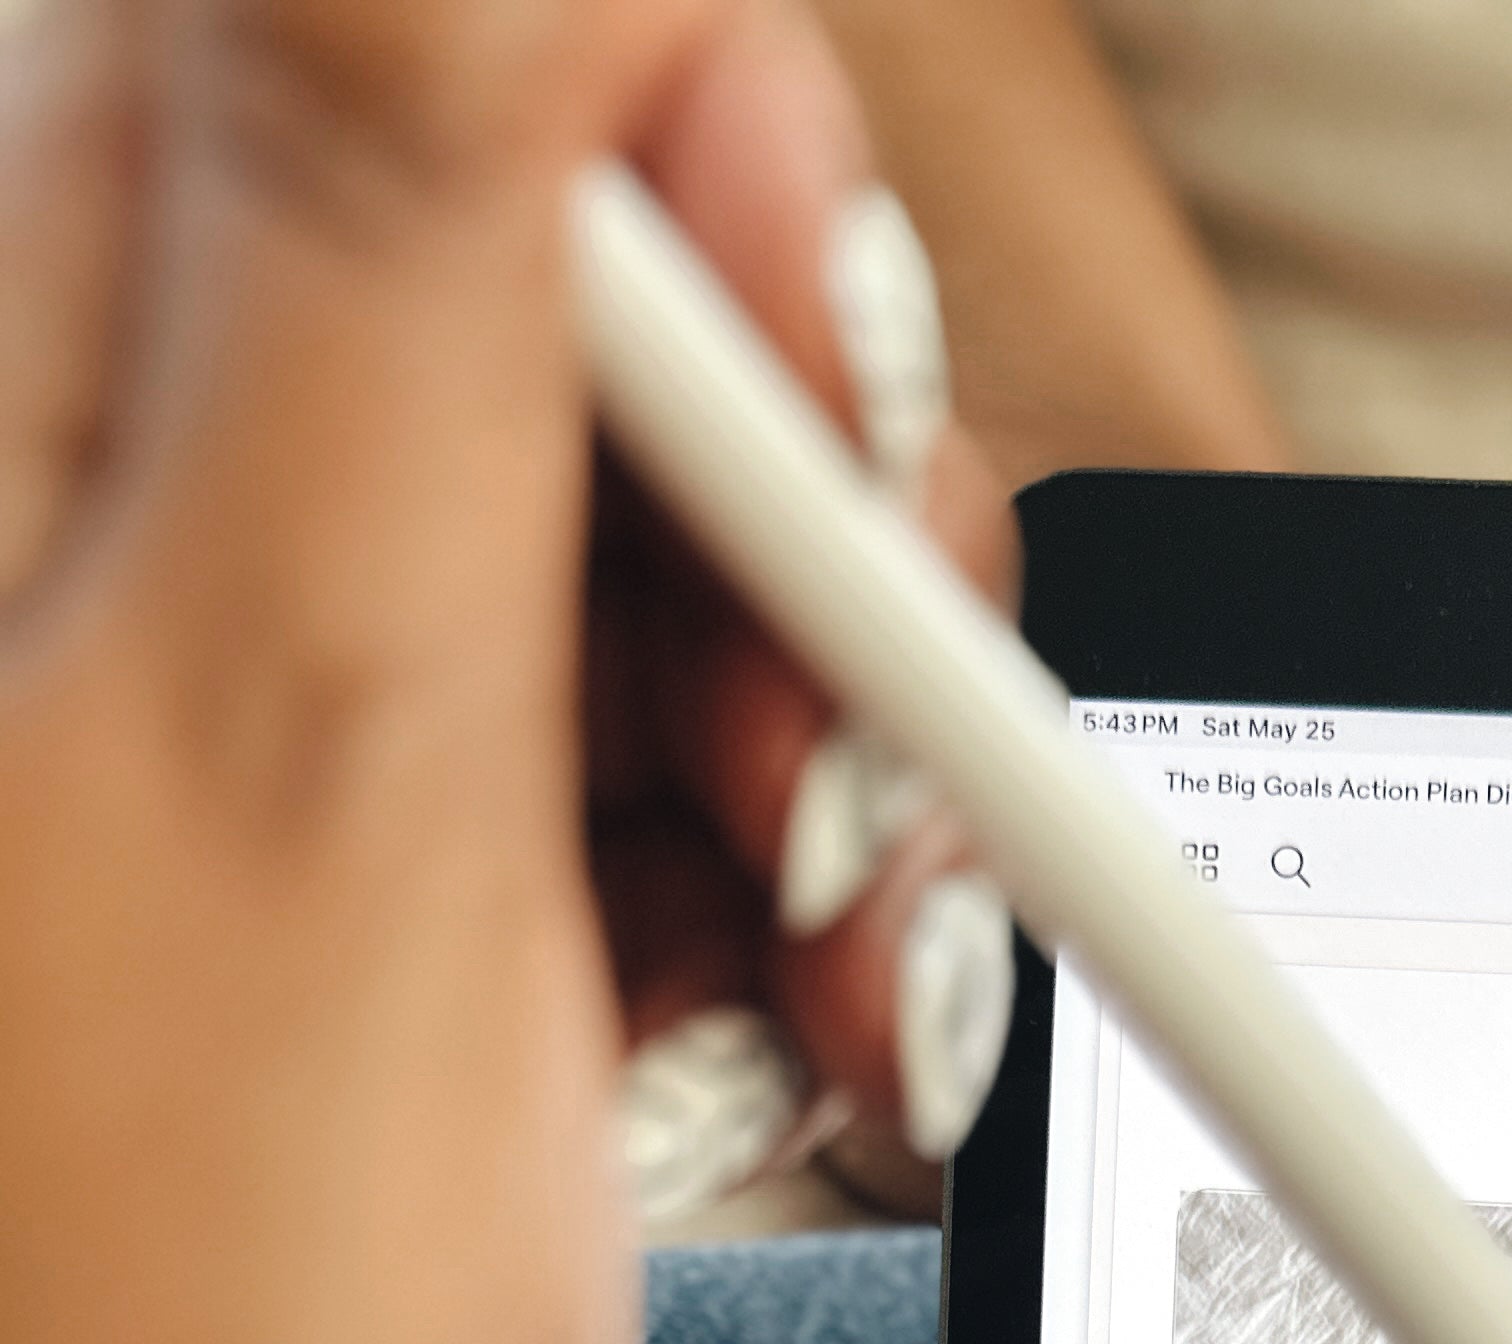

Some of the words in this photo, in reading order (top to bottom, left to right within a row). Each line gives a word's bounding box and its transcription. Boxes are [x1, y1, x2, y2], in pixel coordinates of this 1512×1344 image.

[1202, 717, 1240, 737] Sat
[1249, 719, 1297, 743] May
[1306, 722, 1335, 741] 25
[1165, 770, 1210, 794] The
[1217, 773, 1255, 800] Big
[1264, 775, 1332, 798] Goals
[1338, 778, 1418, 802] Action
[1427, 780, 1478, 804] Plan
